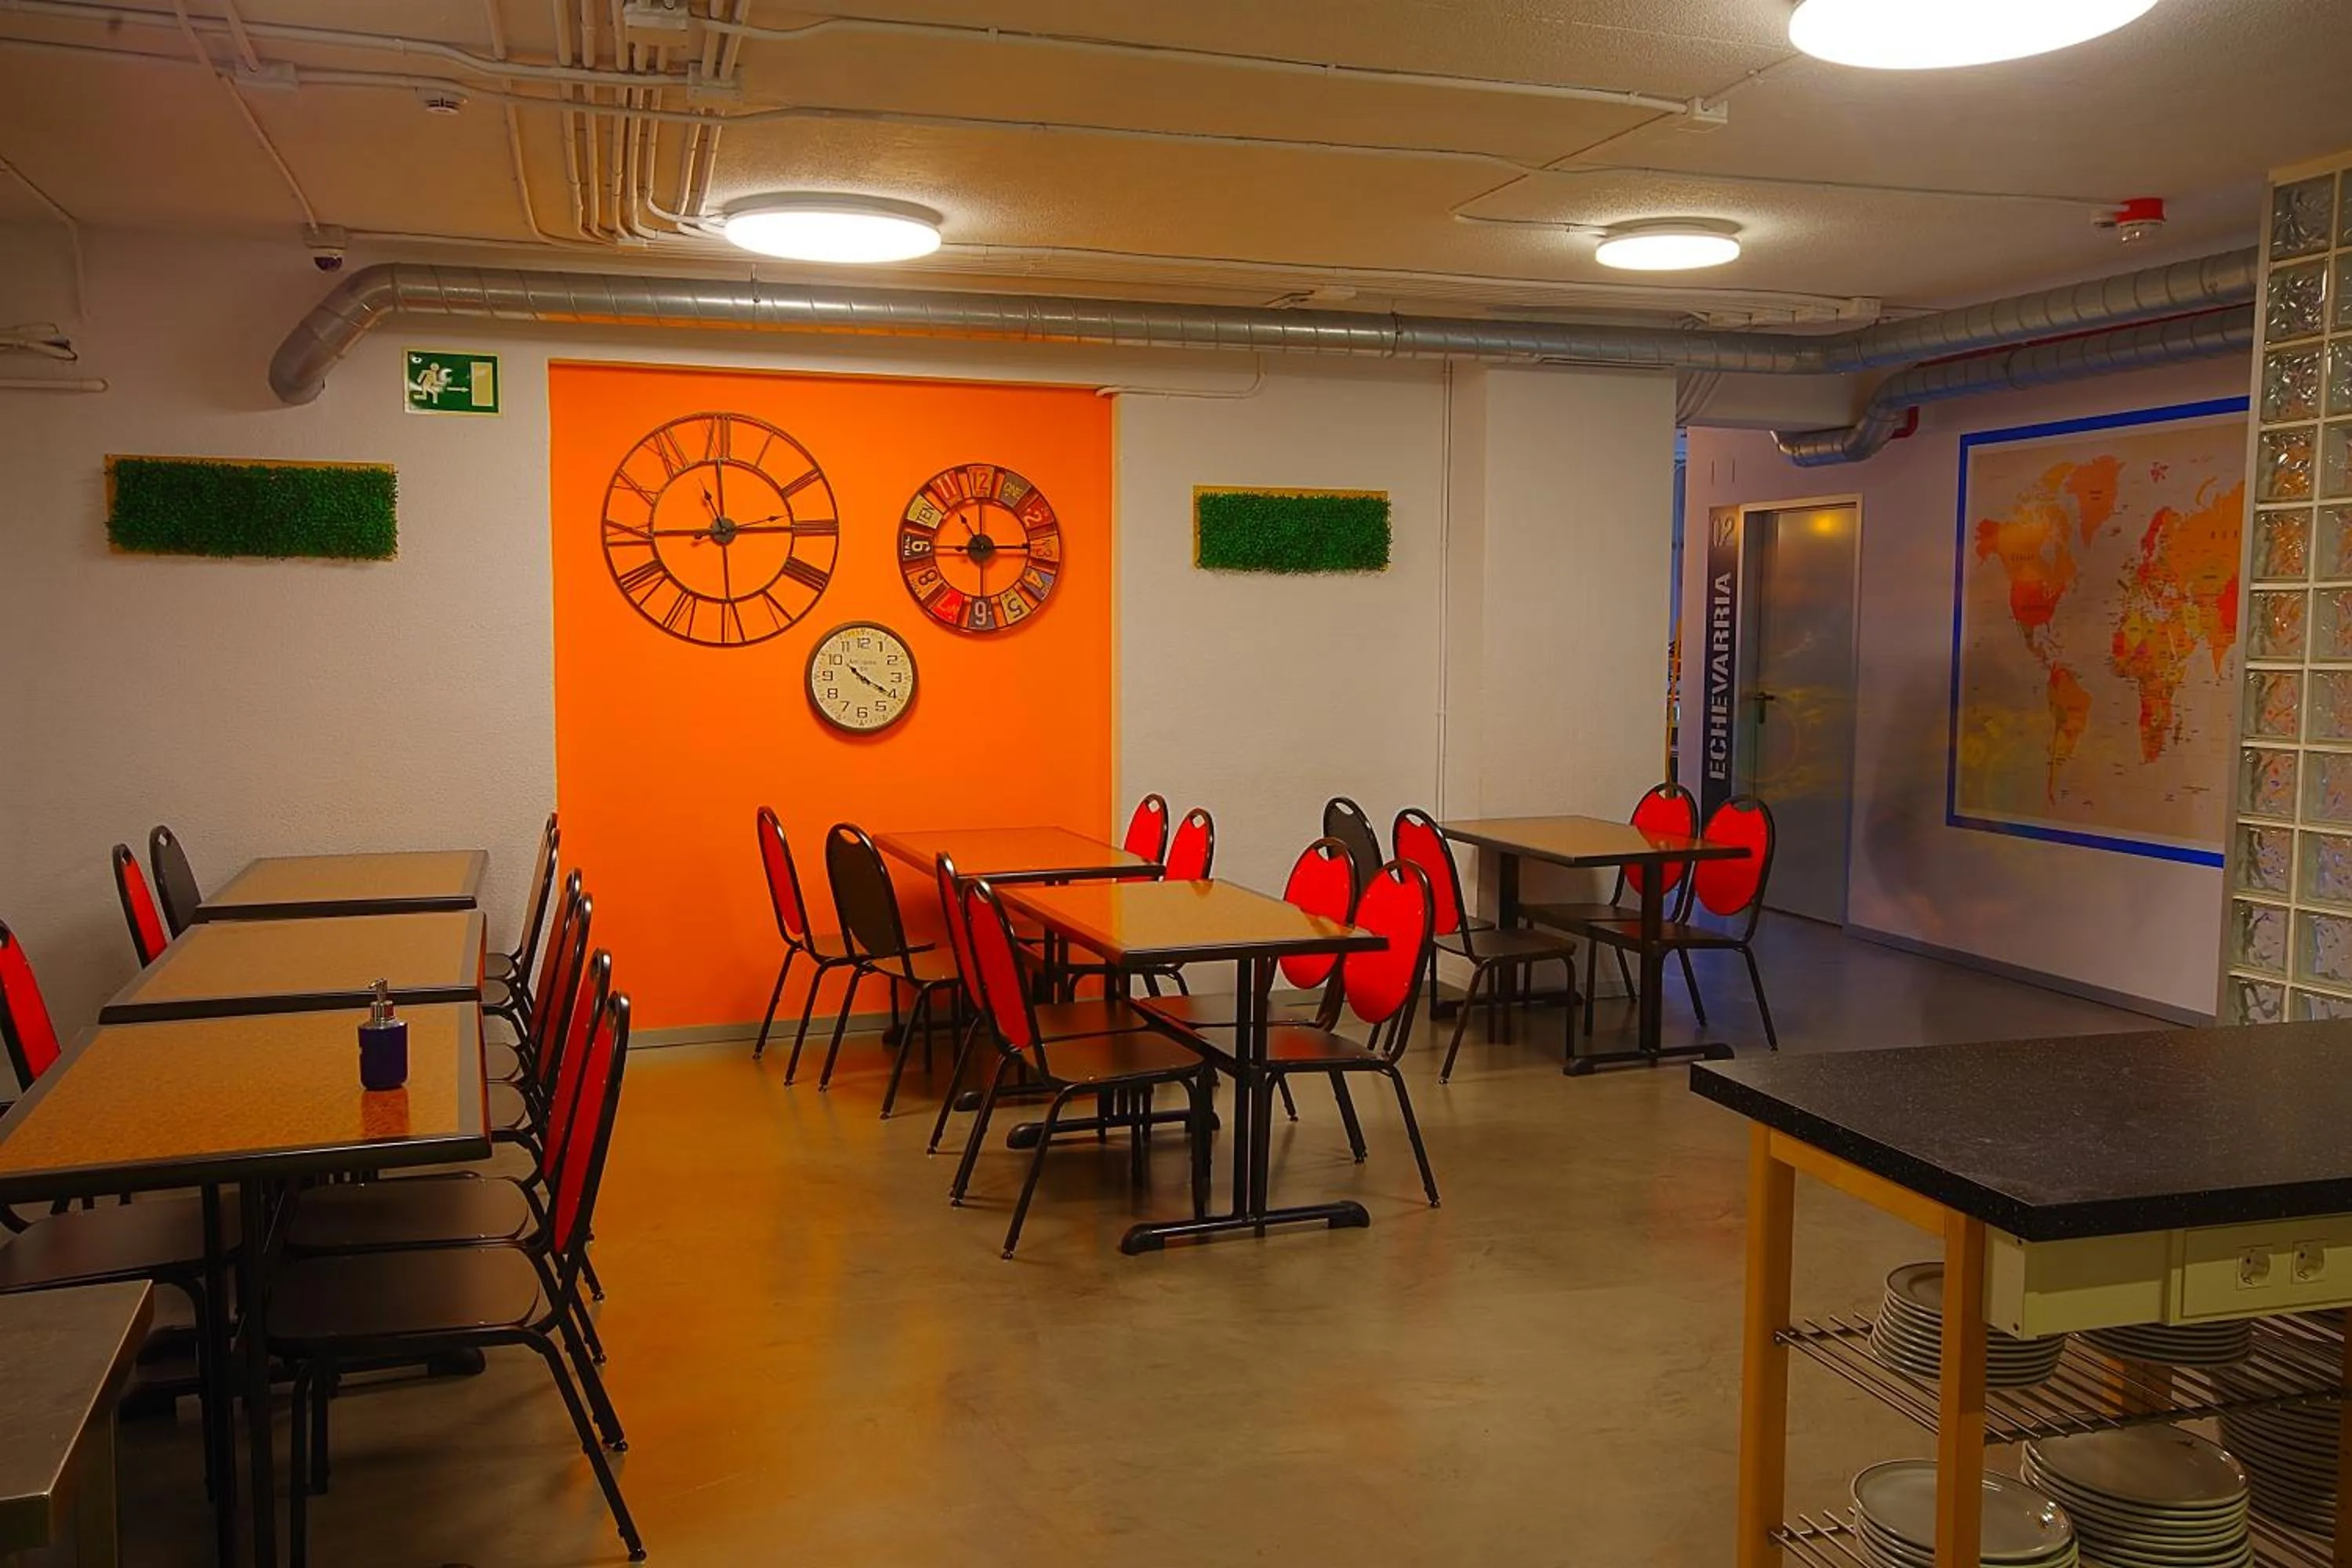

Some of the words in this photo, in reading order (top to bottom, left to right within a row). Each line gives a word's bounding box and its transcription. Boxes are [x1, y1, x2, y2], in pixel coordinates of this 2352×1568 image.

[937, 474, 957, 499] 11
[972, 472, 989, 491] 12
[916, 506, 935, 524] TEN
[1023, 511, 1044, 528] 2
[1711, 516, 1735, 547] 02
[912, 541, 931, 552] 9
[919, 570, 938, 586] 8
[1024, 568, 1045, 590] 4
[975, 601, 987, 626] 6
[1007, 598, 1023, 619] 5
[841, 641, 850, 652] 11
[857, 637, 871, 649] 12
[878, 641, 884, 652] 1
[829, 654, 843, 666] 10
[887, 655, 898, 666] 2
[822, 670, 833, 681] 9
[891, 672, 902, 683] 3
[1709, 573, 1732, 780] ECHEVARRIA
[827, 688, 838, 699] 8
[887, 688, 897, 699] 4
[840, 700, 851, 712] 7
[875, 700, 887, 711] 5
[857, 706, 868, 718] 6
